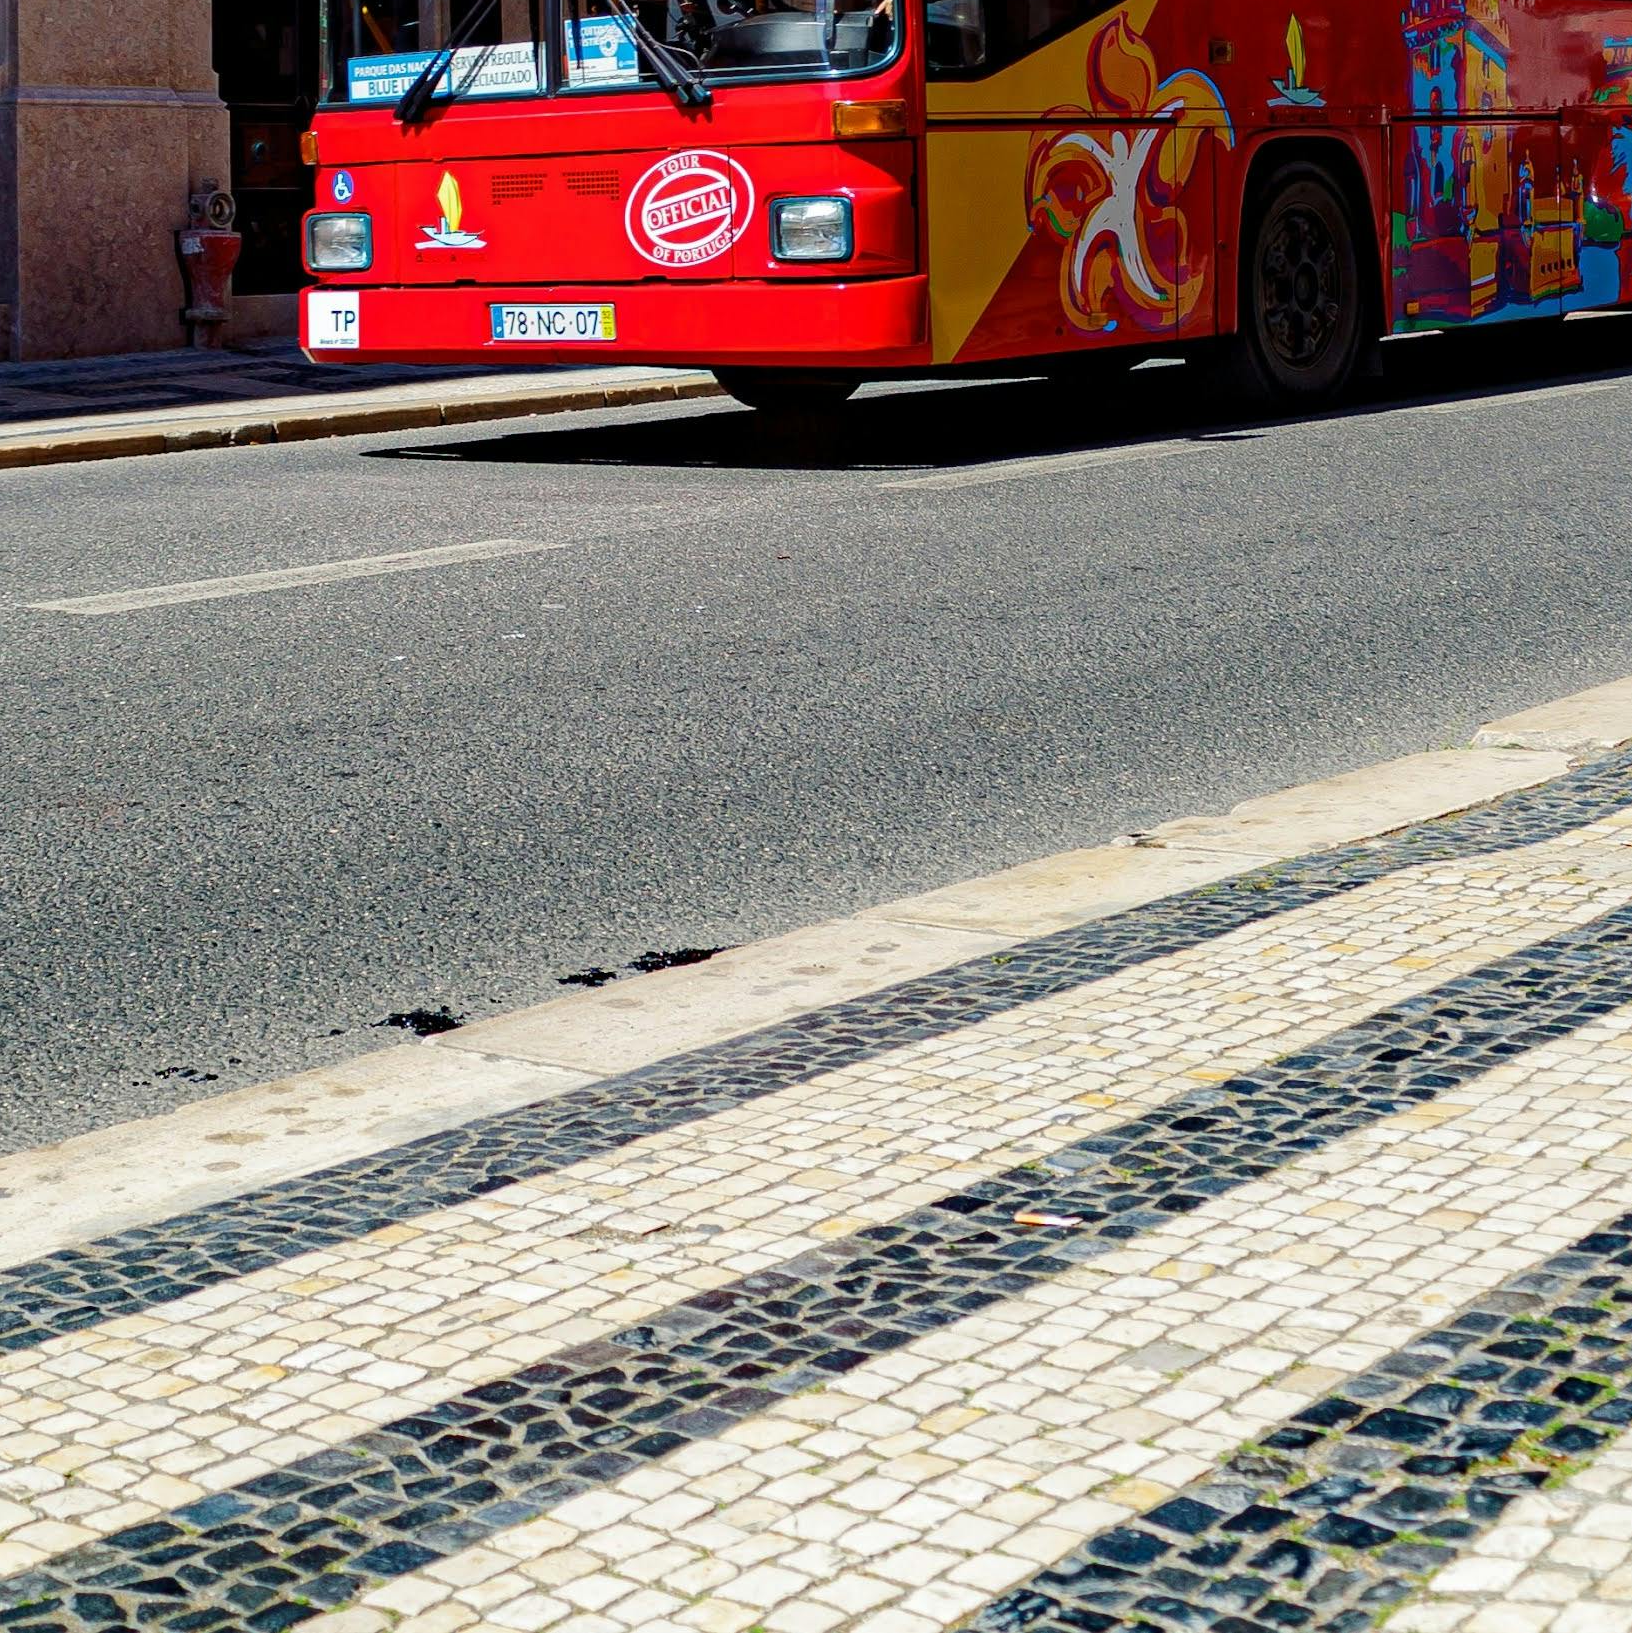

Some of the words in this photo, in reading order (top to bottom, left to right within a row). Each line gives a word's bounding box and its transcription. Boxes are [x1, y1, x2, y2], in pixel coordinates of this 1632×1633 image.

[368, 79, 398, 96] BLUE
[657, 154, 701, 179] TOUR
[647, 188, 731, 229] OFFICIAL
[653, 245, 671, 262] OF
[330, 310, 356, 332] TP
